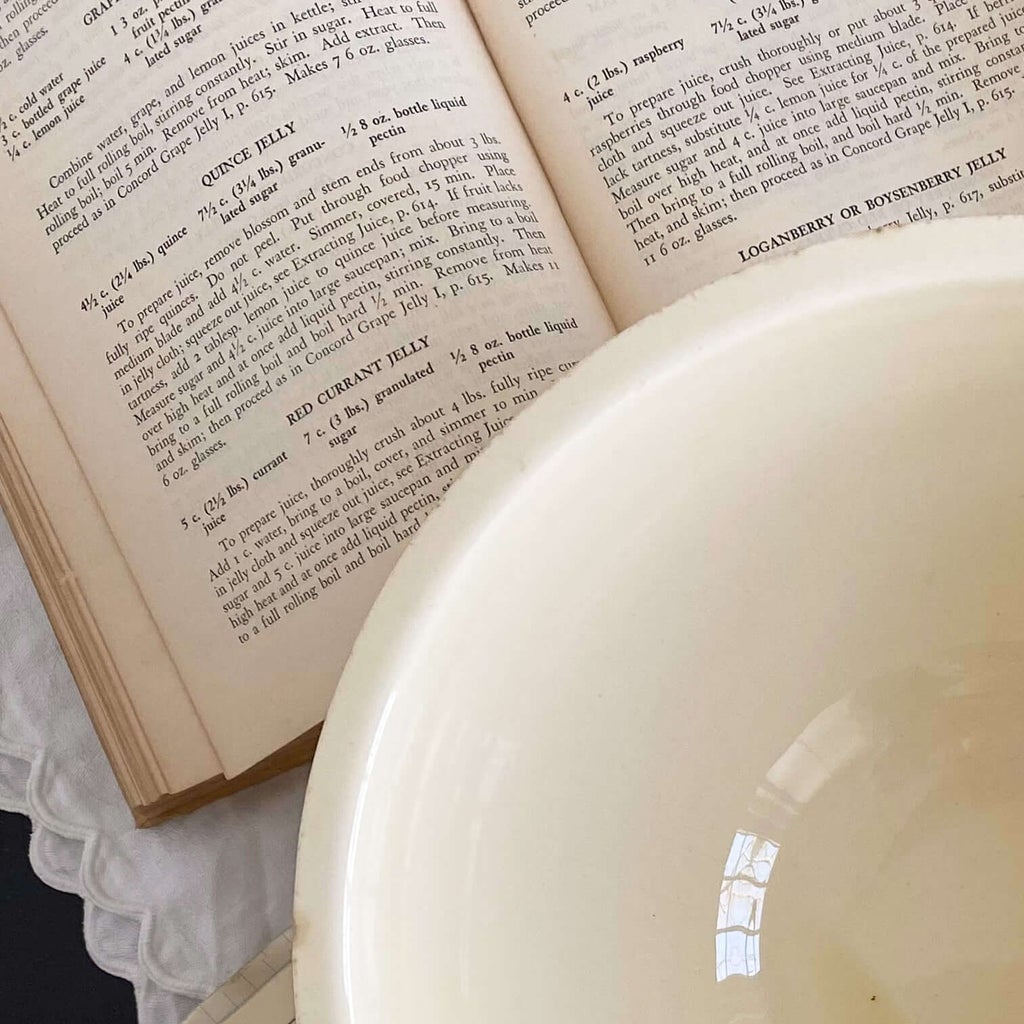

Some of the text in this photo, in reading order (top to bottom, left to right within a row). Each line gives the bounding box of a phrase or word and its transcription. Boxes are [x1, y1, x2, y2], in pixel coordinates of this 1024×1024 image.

[19, 72, 64, 114] cold water
[49, 2, 335, 189] Combine water, grape, and lemon juices in kettle;
[563, 38, 684, 103] 4 c. (2 lbs.) raspberry
[359, 118, 368, 130] 8
[372, 115, 391, 125] oz.
[392, 101, 429, 119] bottle
[430, 96, 467, 111] liquid
[586, 88, 614, 111] juice
[201, 121, 296, 187] QUINCE JELLY
[369, 125, 406, 148] pectin
[219, 198, 228, 207] c.
[257, 160, 283, 181] lbs.)
[288, 141, 325, 168] granu-
[220, 182, 278, 225] lated sugar
[738, 147, 1006, 263] LOGANBERRY OR BOYSENBERRY JELLY
[942, 201, 955, 214] p.
[959, 190, 984, 204] 617,
[100, 290, 109, 298] c.
[132, 251, 155, 273] lbs.)
[157, 227, 188, 256] quince
[101, 295, 125, 320] juice
[286, 335, 429, 426] RED CURRANT JELLY
[303, 361, 435, 445] 7 c. (3 lbs.) granulated
[328, 425, 357, 448] sugar
[181, 517, 189, 530] 5
[192, 515, 201, 523] c.
[226, 477, 249, 498] lbs.)
[253, 451, 288, 480] currant
[202, 514, 226, 536] juice
